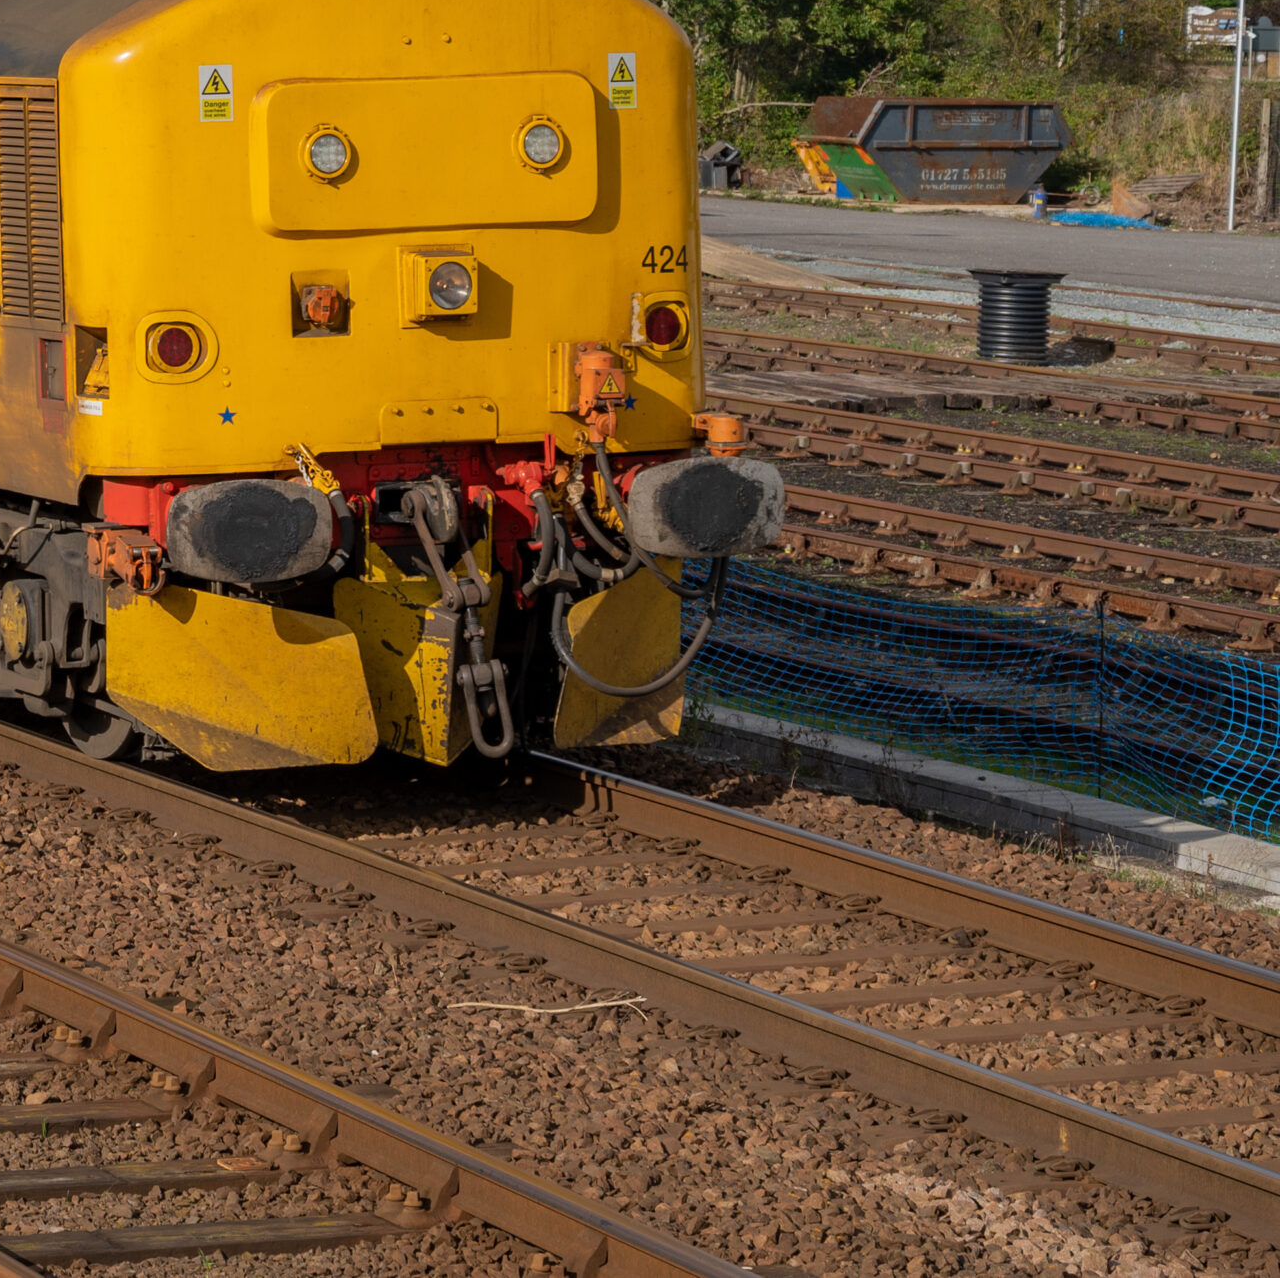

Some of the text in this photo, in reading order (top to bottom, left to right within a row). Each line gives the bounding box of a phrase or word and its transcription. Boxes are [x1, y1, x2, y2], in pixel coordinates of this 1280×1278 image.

[204, 101, 229, 109] Danger
[921, 168, 959, 181] 01727
[642, 245, 689, 273] 424
